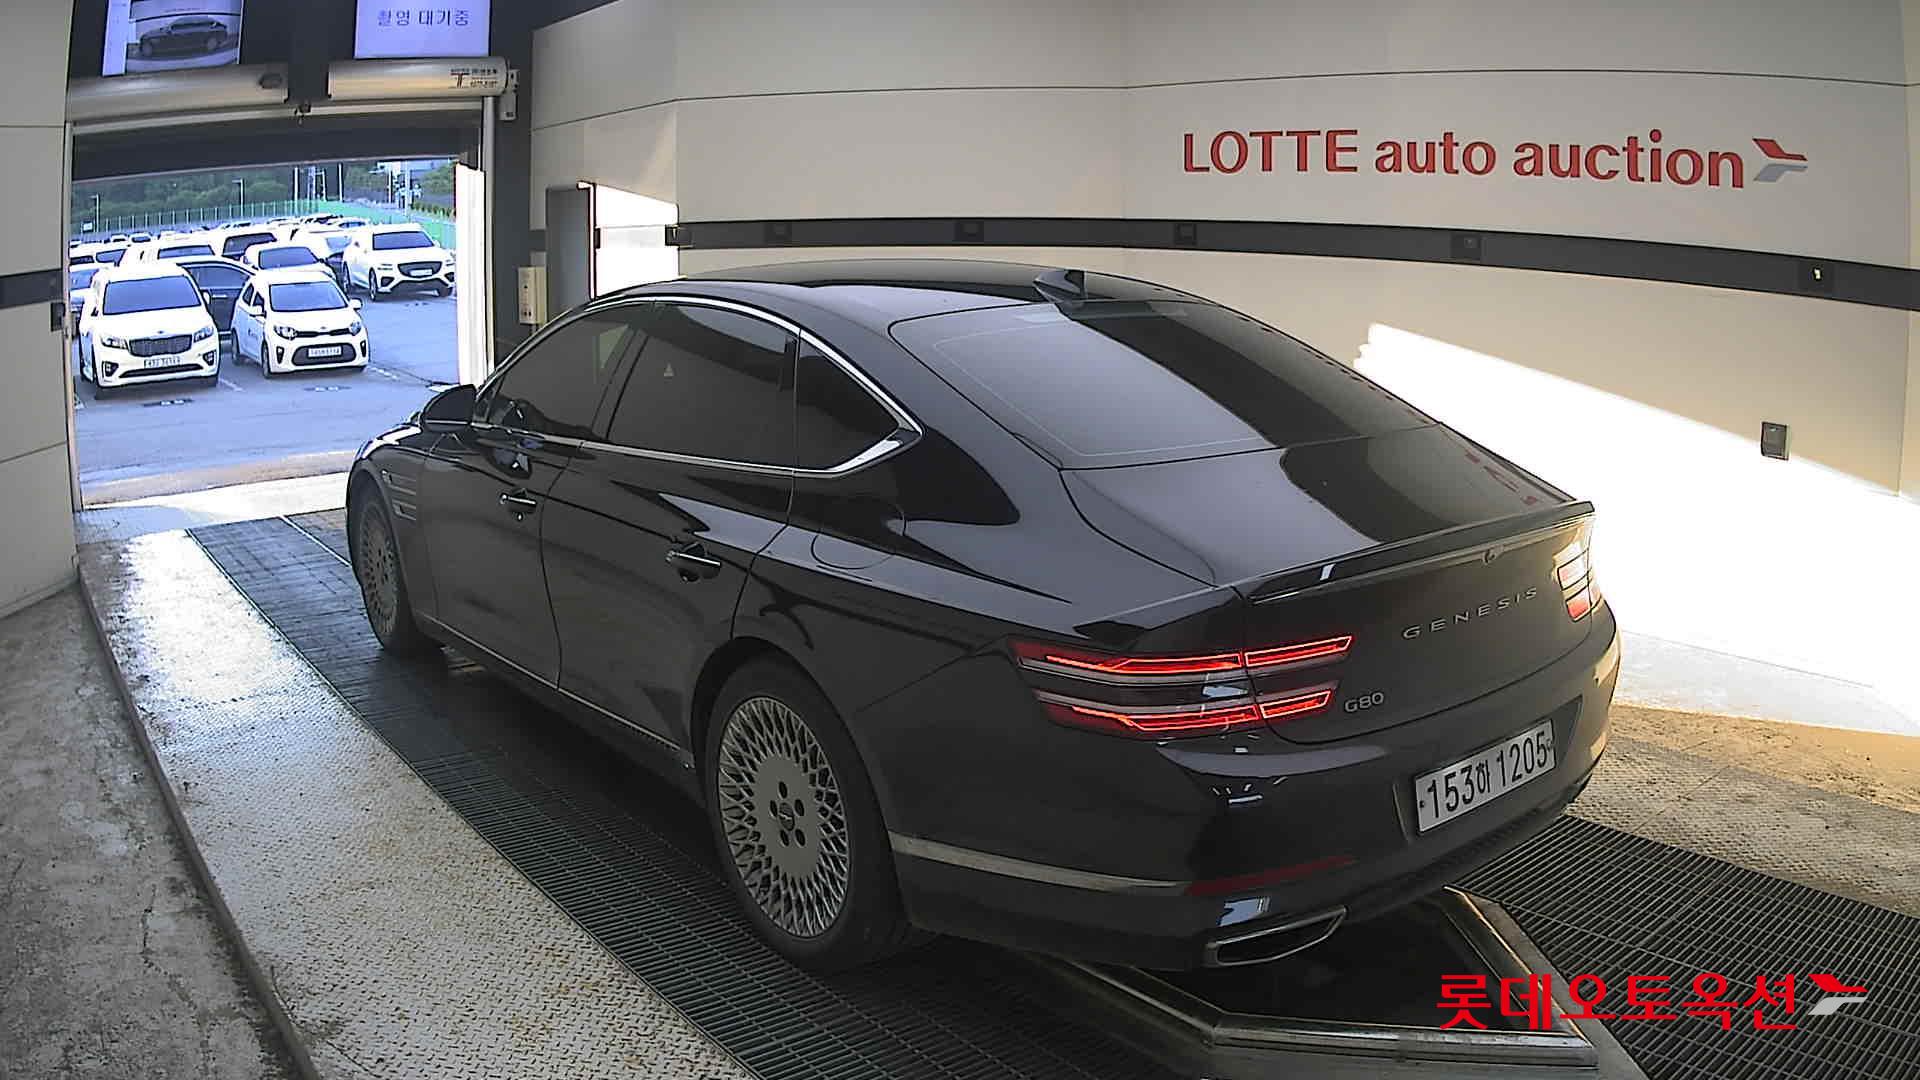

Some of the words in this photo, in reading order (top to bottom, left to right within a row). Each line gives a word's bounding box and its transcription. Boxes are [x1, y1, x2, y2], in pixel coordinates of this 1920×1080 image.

[418, 9, 470, 26] 대기중
[1184, 129, 1359, 174] LOTTE
[1376, 130, 1497, 176] auto
[1514, 129, 1744, 188] auction
[1402, 587, 1537, 639] GENESIS
[1344, 692, 1384, 713] G80
[1427, 762, 1490, 818] 153하
[1497, 731, 1548, 788] 1205
